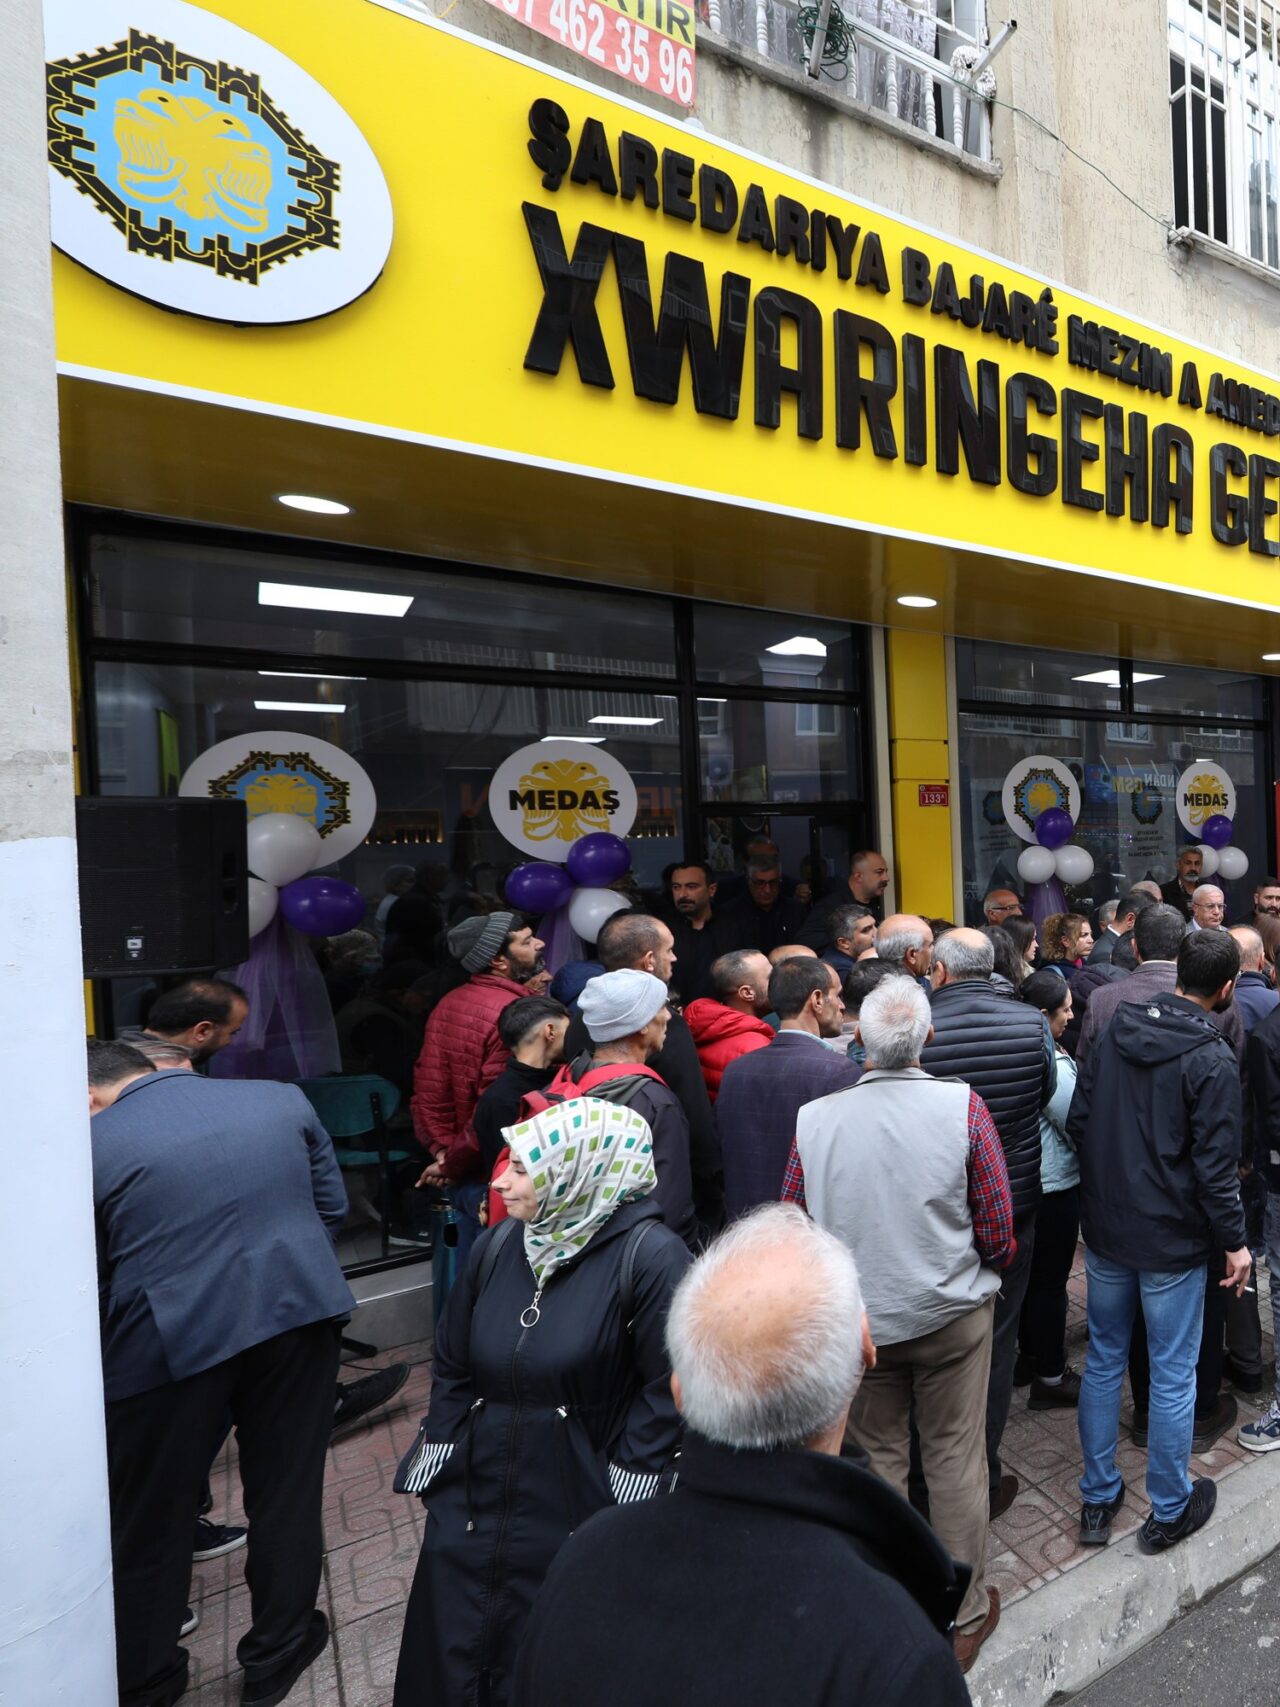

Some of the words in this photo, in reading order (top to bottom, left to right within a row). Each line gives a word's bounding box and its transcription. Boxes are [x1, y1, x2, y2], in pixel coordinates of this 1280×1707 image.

[550, 0, 605, 62] 462
[615, 17, 649, 84] 35
[659, 39, 692, 103] 96
[527, 98, 890, 295] ŞAREDARIYA
[901, 246, 1059, 356] BAJARÊ
[1066, 314, 1173, 398] MEZIN
[1178, 361, 1203, 409] A
[521, 201, 1194, 535] XWARINGEHA
[509, 789, 621, 815] MEDAŞ
[1183, 793, 1229, 810] MEDAŞ
